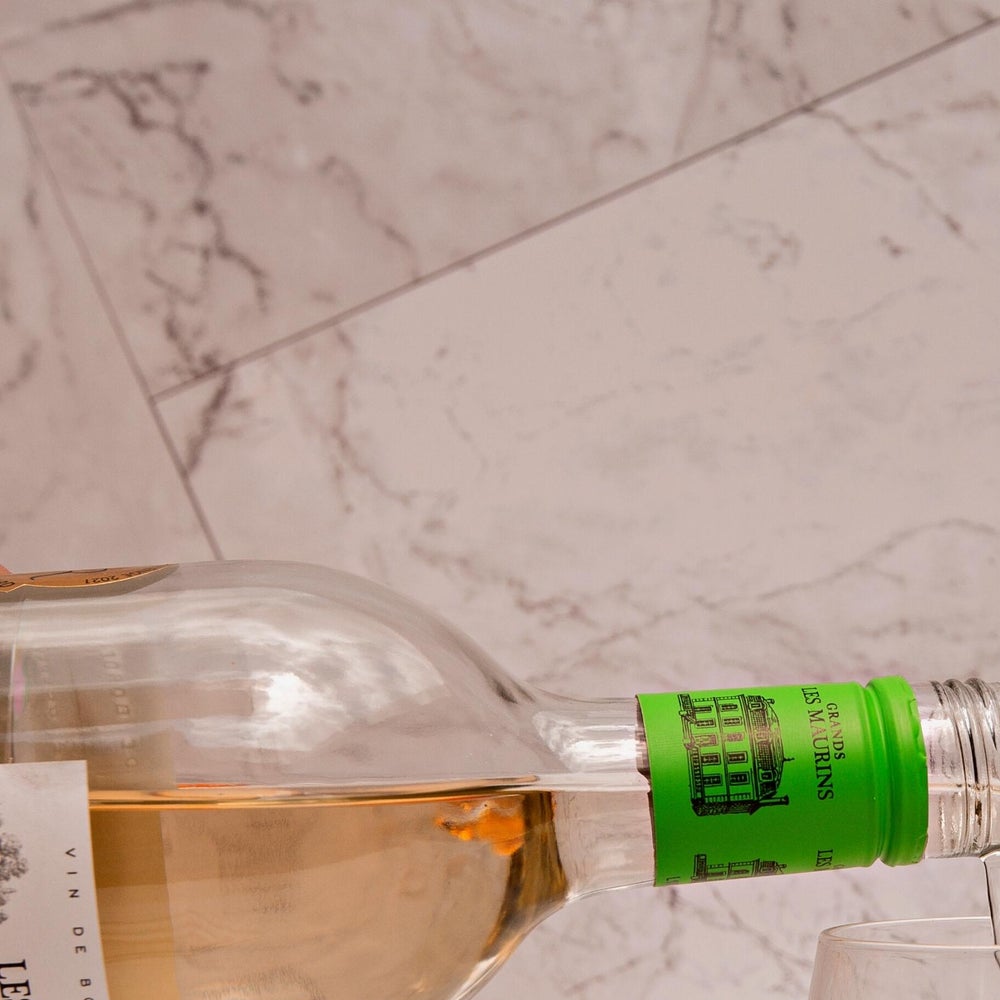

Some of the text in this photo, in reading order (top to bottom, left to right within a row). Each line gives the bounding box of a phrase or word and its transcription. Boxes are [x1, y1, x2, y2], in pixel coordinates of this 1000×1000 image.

[801, 687, 835, 801] LES MAURINS
[826, 702, 846, 760] GRANDS
[65, 847, 80, 898] VIN
[73, 927, 87, 954] DE
